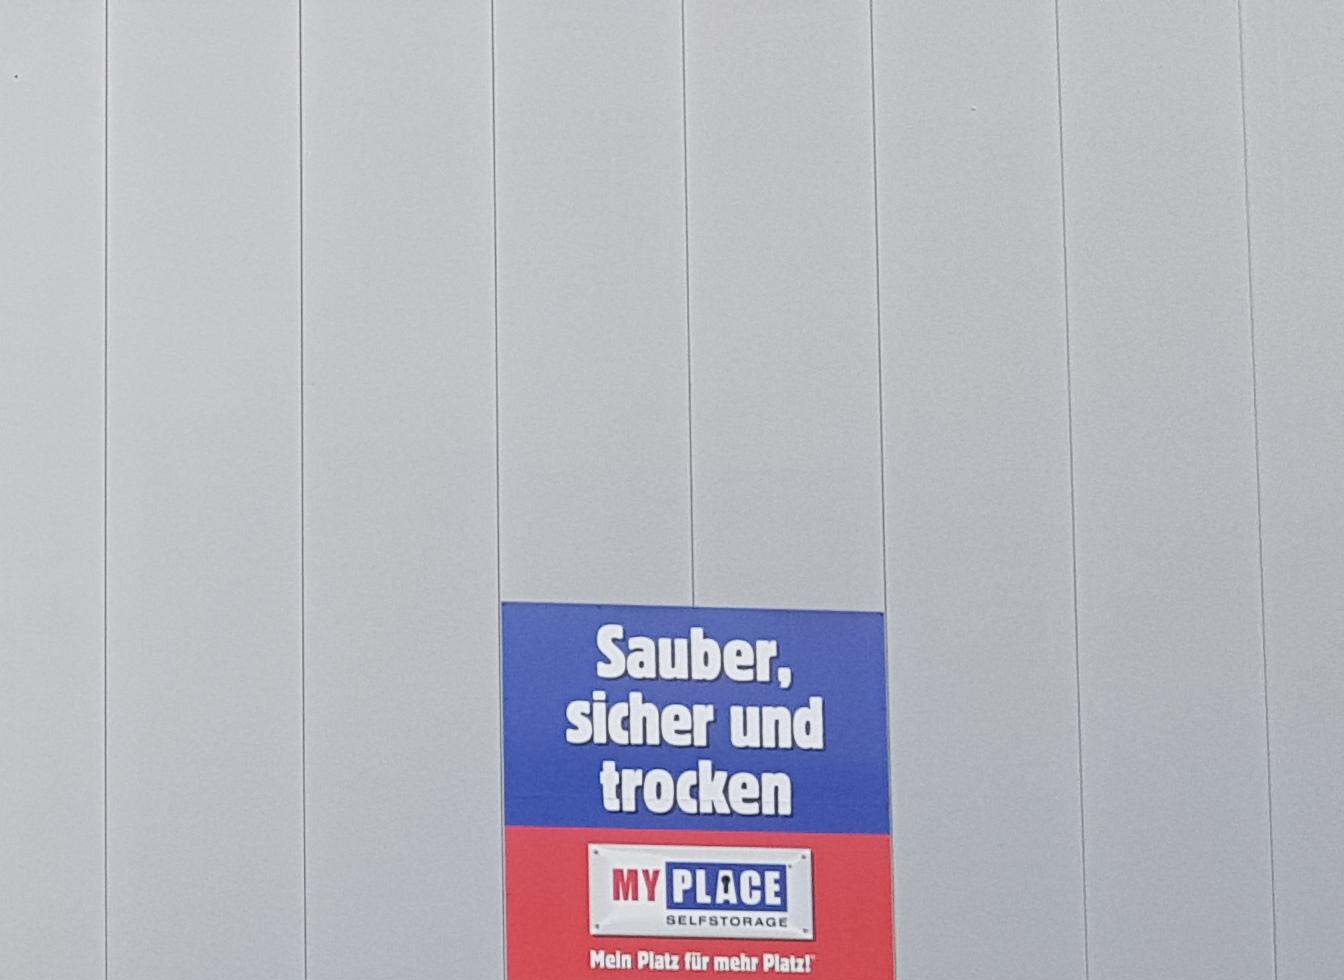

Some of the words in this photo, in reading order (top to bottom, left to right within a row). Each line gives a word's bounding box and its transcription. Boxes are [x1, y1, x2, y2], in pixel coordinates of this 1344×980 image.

[596, 624, 792, 688] Sauber,
[565, 691, 714, 746] sicher
[730, 696, 824, 750] und
[600, 760, 793, 817] trocken
[612, 868, 661, 902] MY
[671, 868, 782, 906] PLACE
[666, 915, 789, 928] SELFSTORAGE
[590, 949, 632, 970] Mein
[637, 951, 680, 971] Platz
[684, 951, 710, 971] für
[714, 954, 759, 972] mehr
